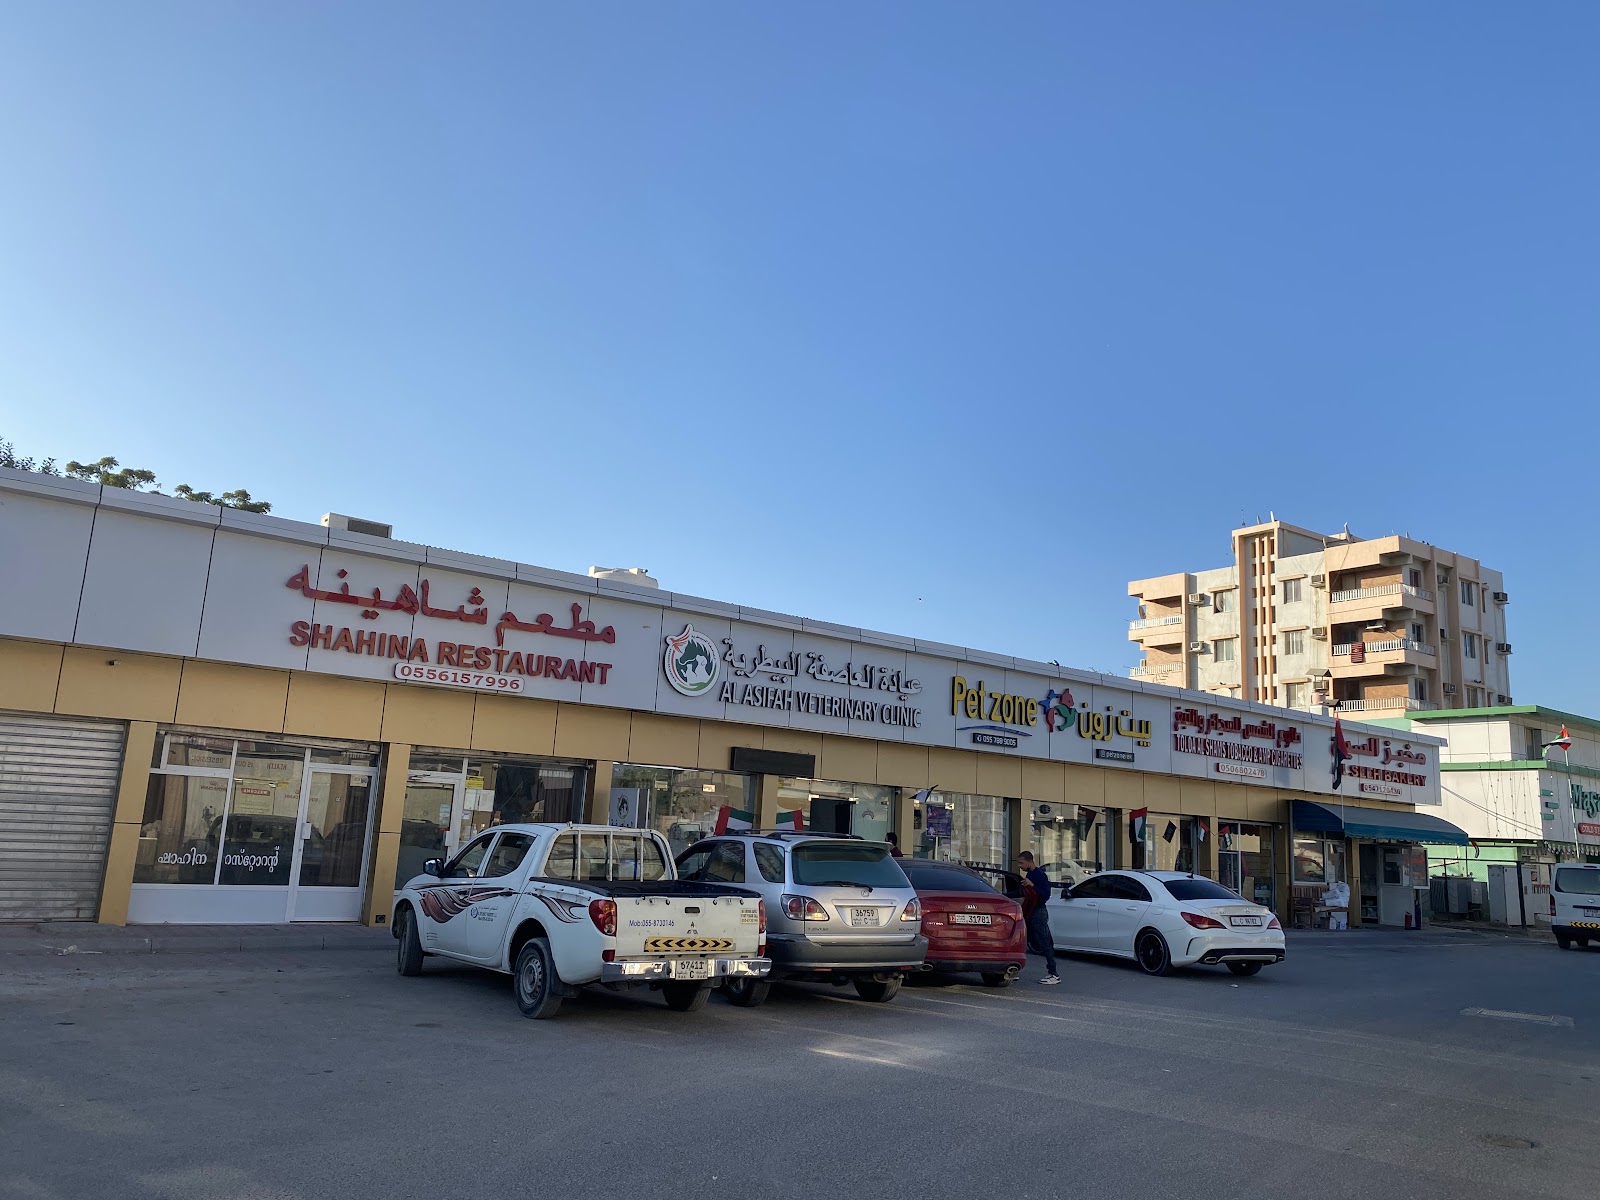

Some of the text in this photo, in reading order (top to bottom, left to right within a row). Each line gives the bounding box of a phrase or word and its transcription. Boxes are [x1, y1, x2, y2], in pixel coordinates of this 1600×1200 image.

[495, 602, 616, 647] مطعم
[289, 620, 429, 663] SHAHINA
[437, 641, 613, 685] RESTAURANT
[722, 637, 800, 683] البيطرية
[400, 664, 521, 690] 0556157996
[807, 651, 876, 689] العاصفة
[879, 666, 923, 701] عيادة
[719, 680, 922, 728] AL ASIFAH VETERINARY CLINIC
[952, 675, 1038, 727] Pet zone
[1077, 702, 1151, 747] بيت زون
[1242, 720, 1275, 739] الشمس
[982, 735, 993, 743] 055
[1205, 738, 1227, 759] SHAMS
[1226, 741, 1253, 762] TOBACCO
[1253, 745, 1259, 763] &
[1381, 740, 1427, 768] مخبز
[1220, 764, 1265, 777] 0506802478
[1384, 768, 1427, 787] BAKERY
[157, 847, 208, 866] ഷാഹിന
[968, 915, 990, 924] 31781
[689, 970, 695, 978] C
